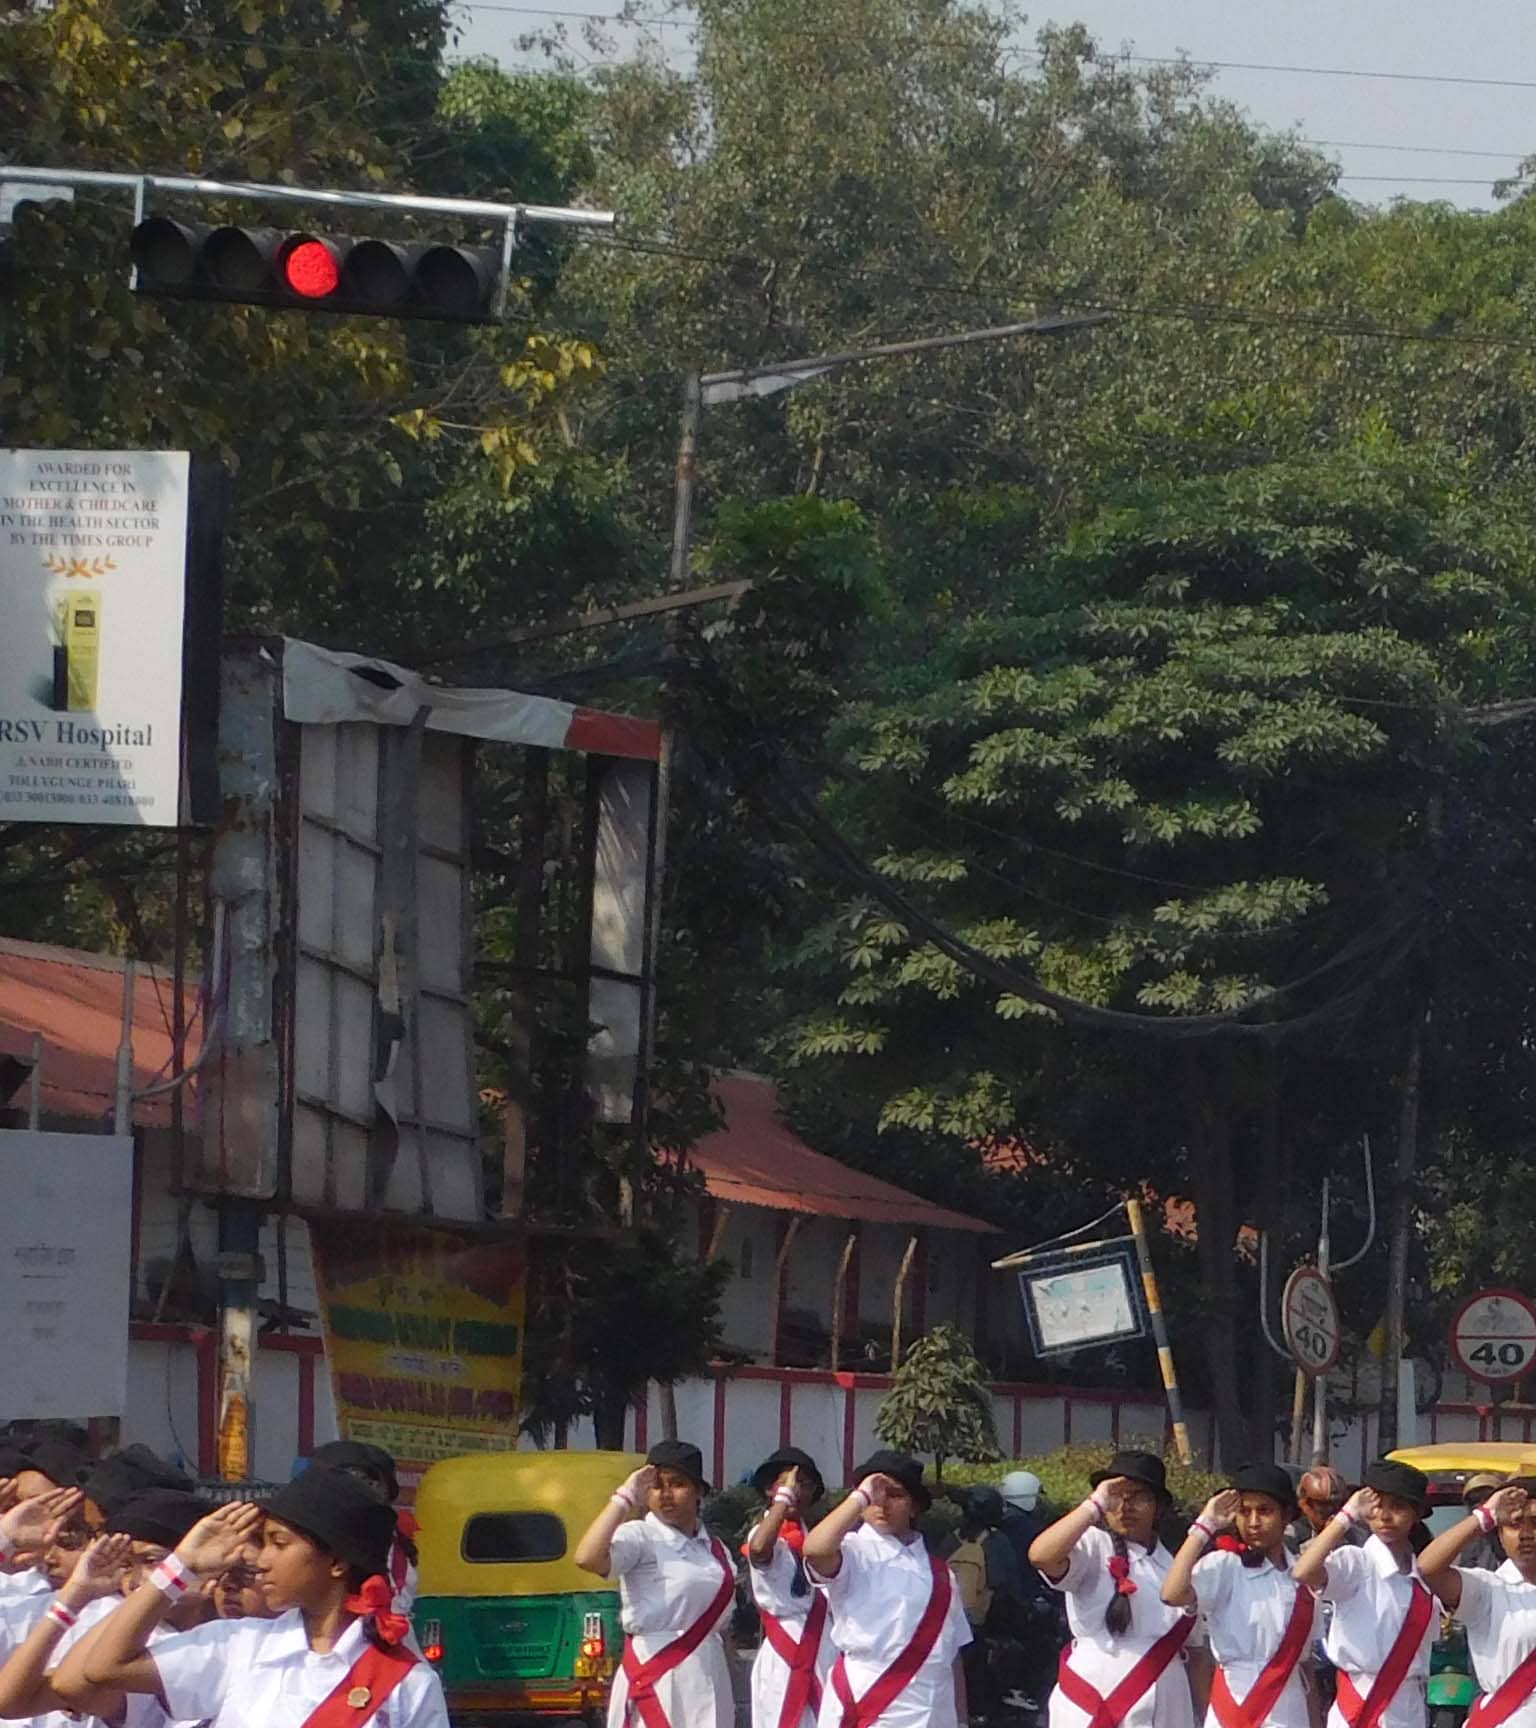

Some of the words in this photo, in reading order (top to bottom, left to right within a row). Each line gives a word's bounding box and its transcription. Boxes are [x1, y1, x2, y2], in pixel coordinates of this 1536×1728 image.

[37, 463, 101, 475] AWARDED
[104, 463, 132, 476] FOR
[29, 480, 117, 493] EXCELLENCE
[122, 482, 136, 493] IN
[3, 498, 64, 511] MOTHER
[65, 500, 74, 511] &
[79, 500, 160, 512] CHILDCARE
[20, 515, 43, 528] THE
[50, 515, 103, 529] HEALTH
[106, 518, 160, 530] SECTOR
[10, 533, 25, 545] BY
[32, 533, 58, 546] THE
[62, 534, 103, 546] TIMES
[106, 536, 153, 548] GROUP
[0, 720, 48, 744] RSV
[56, 720, 152, 751] Hospital
[1296, 1326, 1327, 1358] 40
[1470, 1342, 1525, 1367] 40
